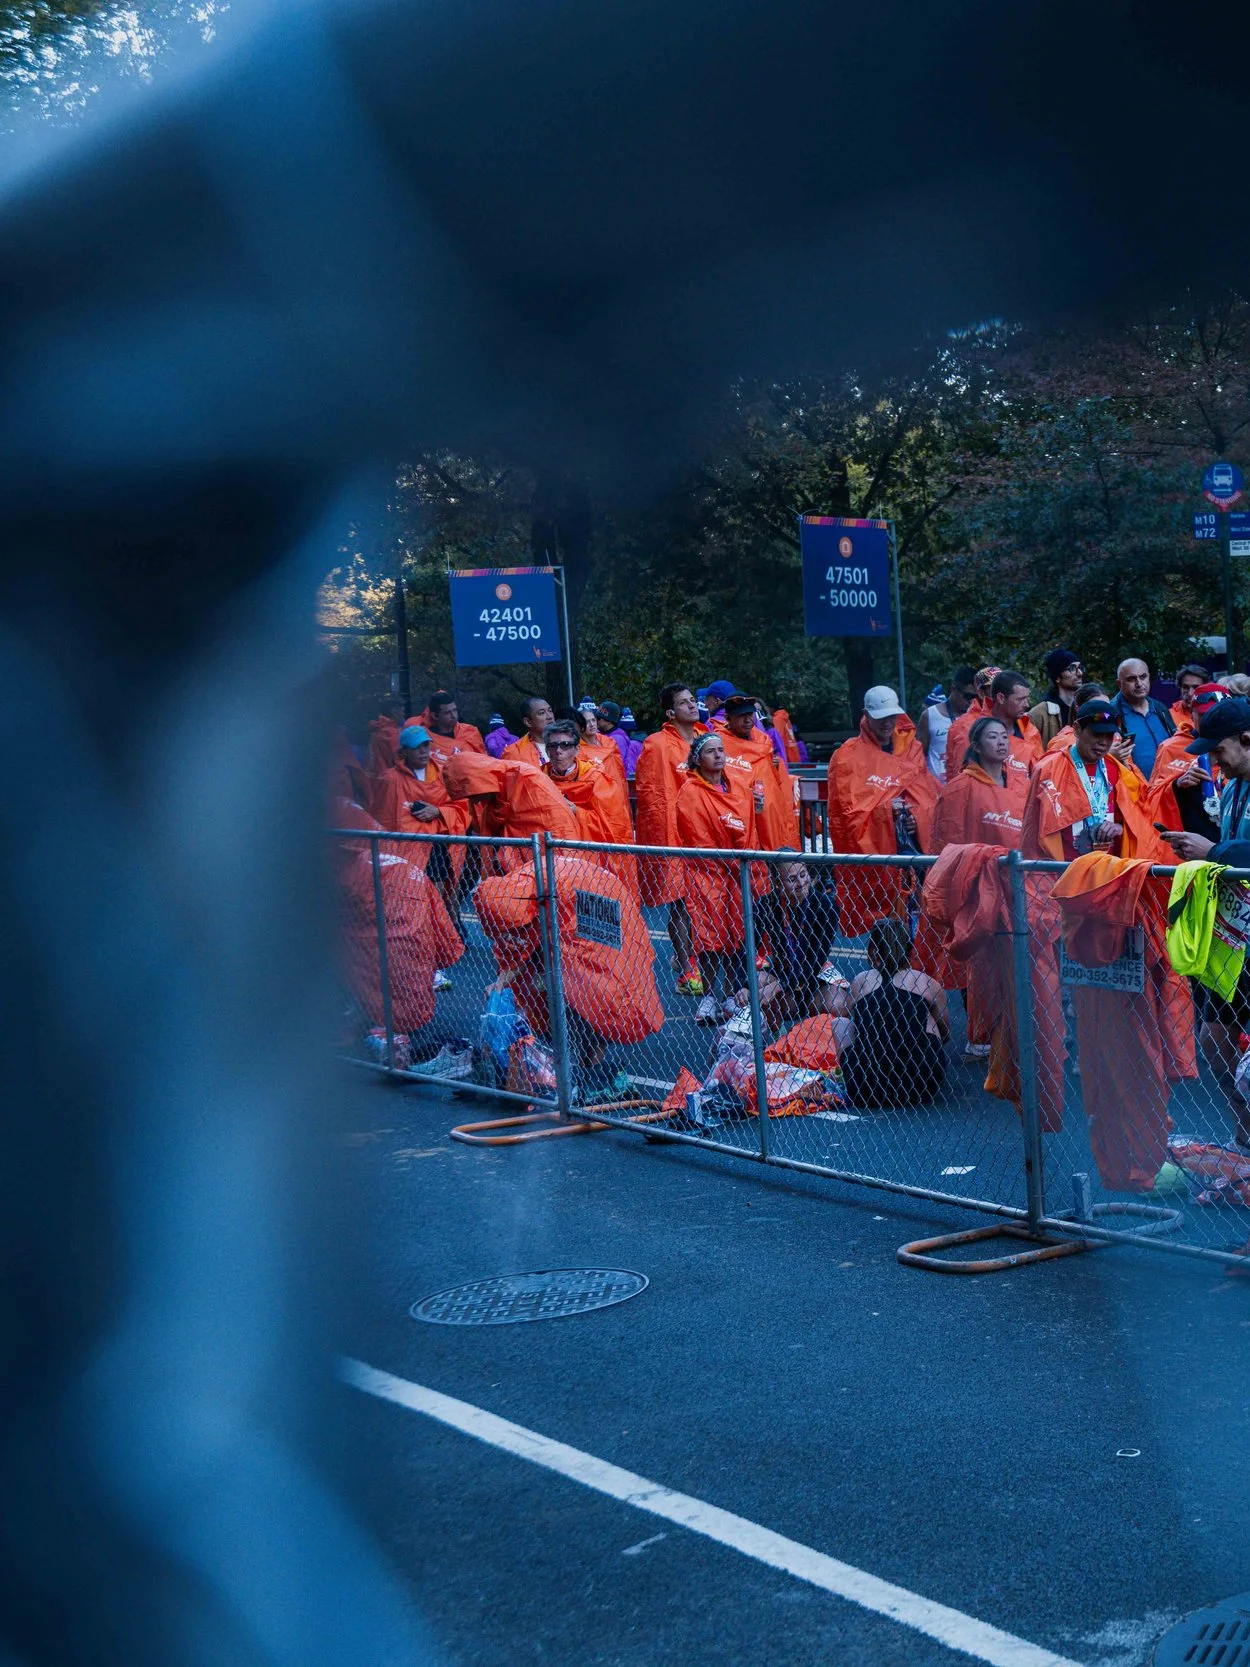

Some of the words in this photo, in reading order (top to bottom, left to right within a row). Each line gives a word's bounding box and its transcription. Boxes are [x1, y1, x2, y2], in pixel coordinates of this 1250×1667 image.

[1195, 515, 1216, 525] M10
[1195, 528, 1216, 538] M72
[825, 566, 869, 585] 47501
[830, 589, 877, 608] 50000
[479, 607, 532, 623] 42401
[485, 625, 542, 641] 47500
